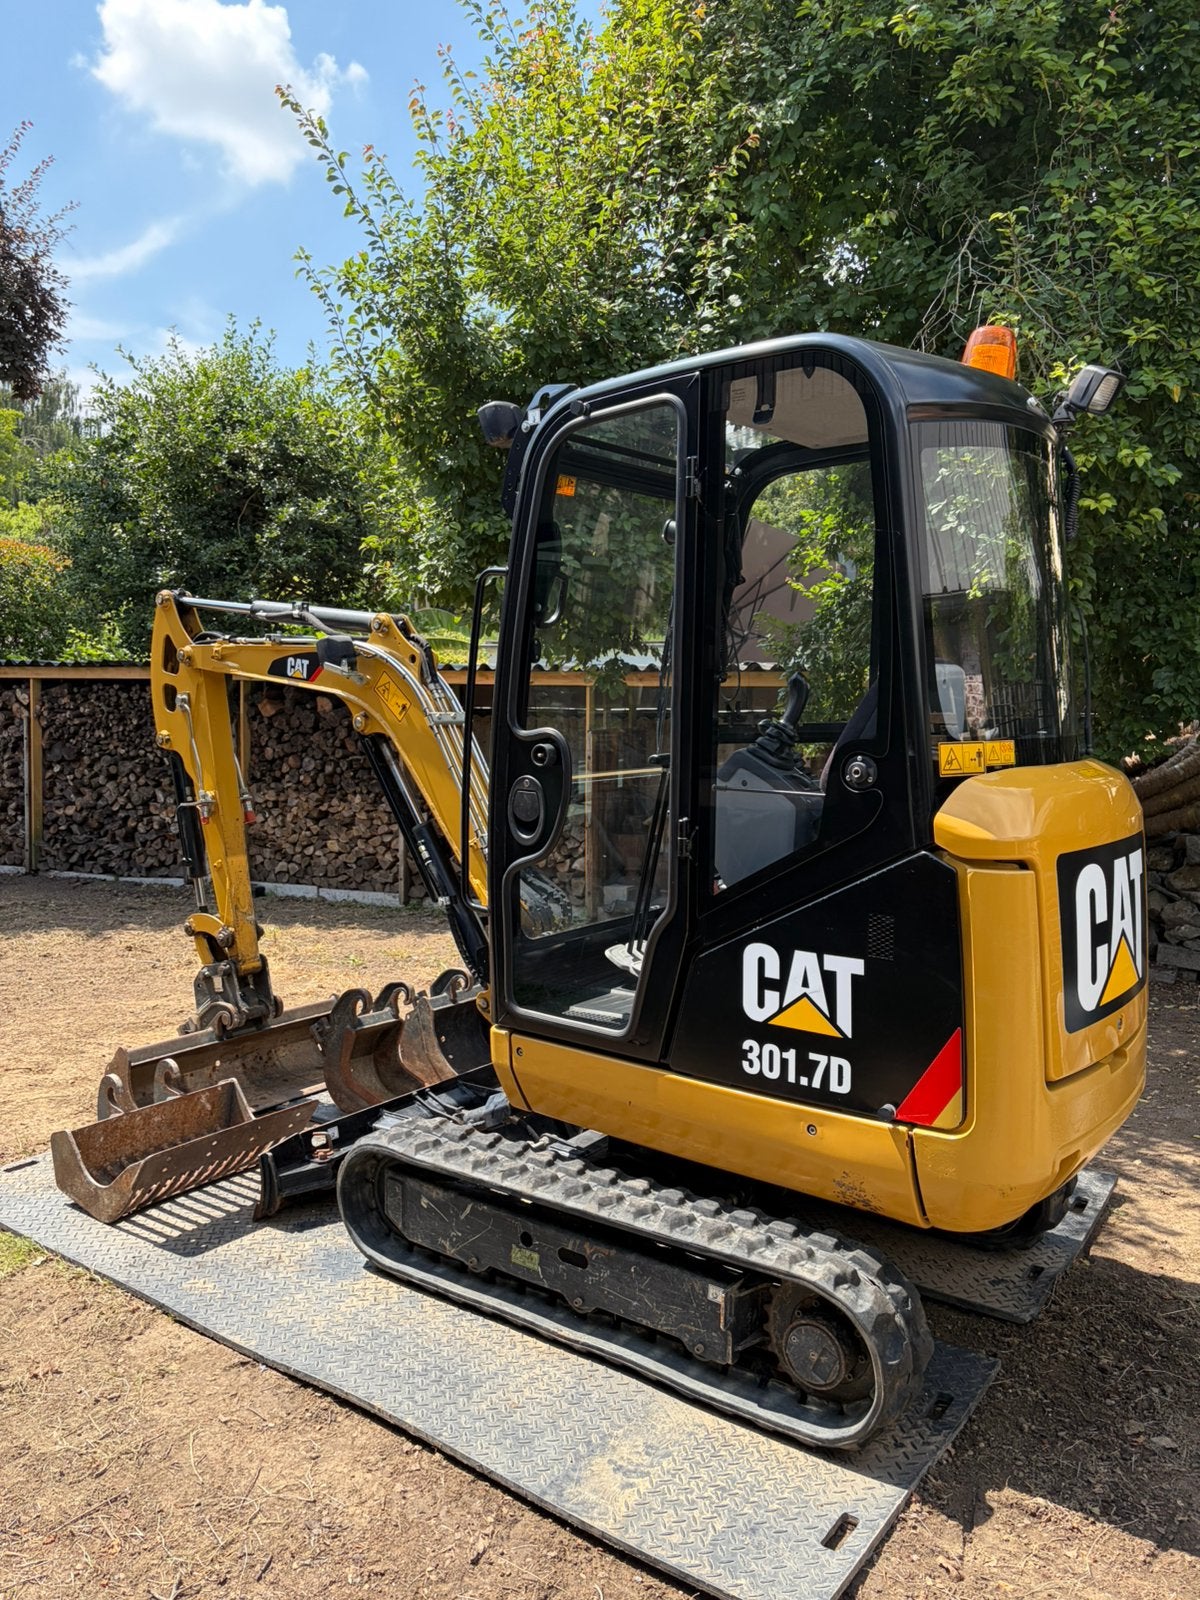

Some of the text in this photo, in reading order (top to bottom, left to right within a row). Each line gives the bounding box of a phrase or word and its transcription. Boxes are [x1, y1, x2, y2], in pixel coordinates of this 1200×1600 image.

[287, 656, 309, 679] CAT
[1075, 848, 1143, 1012] CAT
[742, 942, 865, 1039] CAT
[742, 1039, 852, 1094] 301.7D
